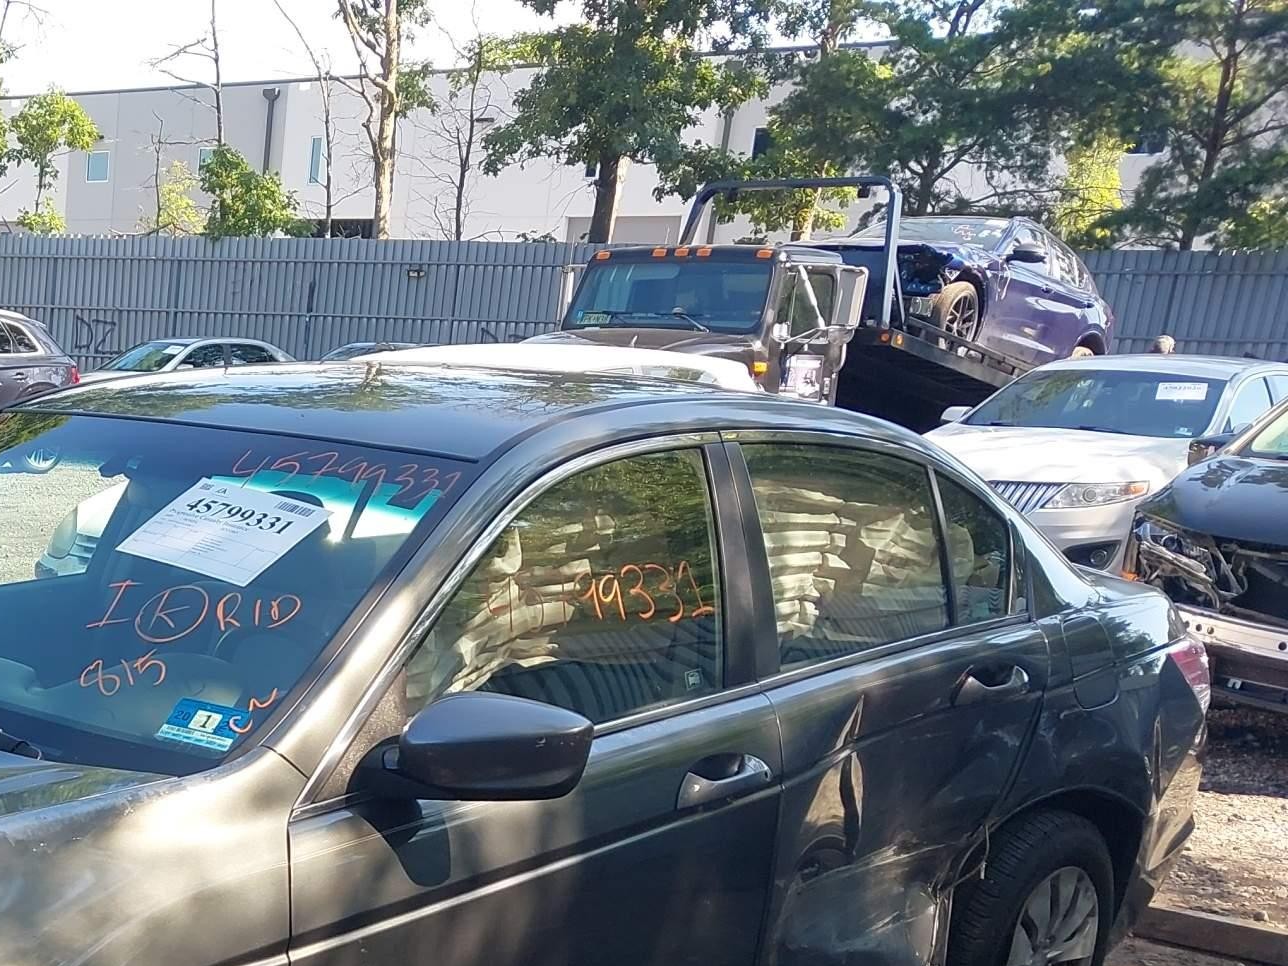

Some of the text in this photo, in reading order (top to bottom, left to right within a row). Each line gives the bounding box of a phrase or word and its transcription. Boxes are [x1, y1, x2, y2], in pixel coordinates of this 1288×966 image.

[186, 498, 294, 535] 45799331
[80, 648, 167, 696] 815
[199, 714, 212, 729] 1
